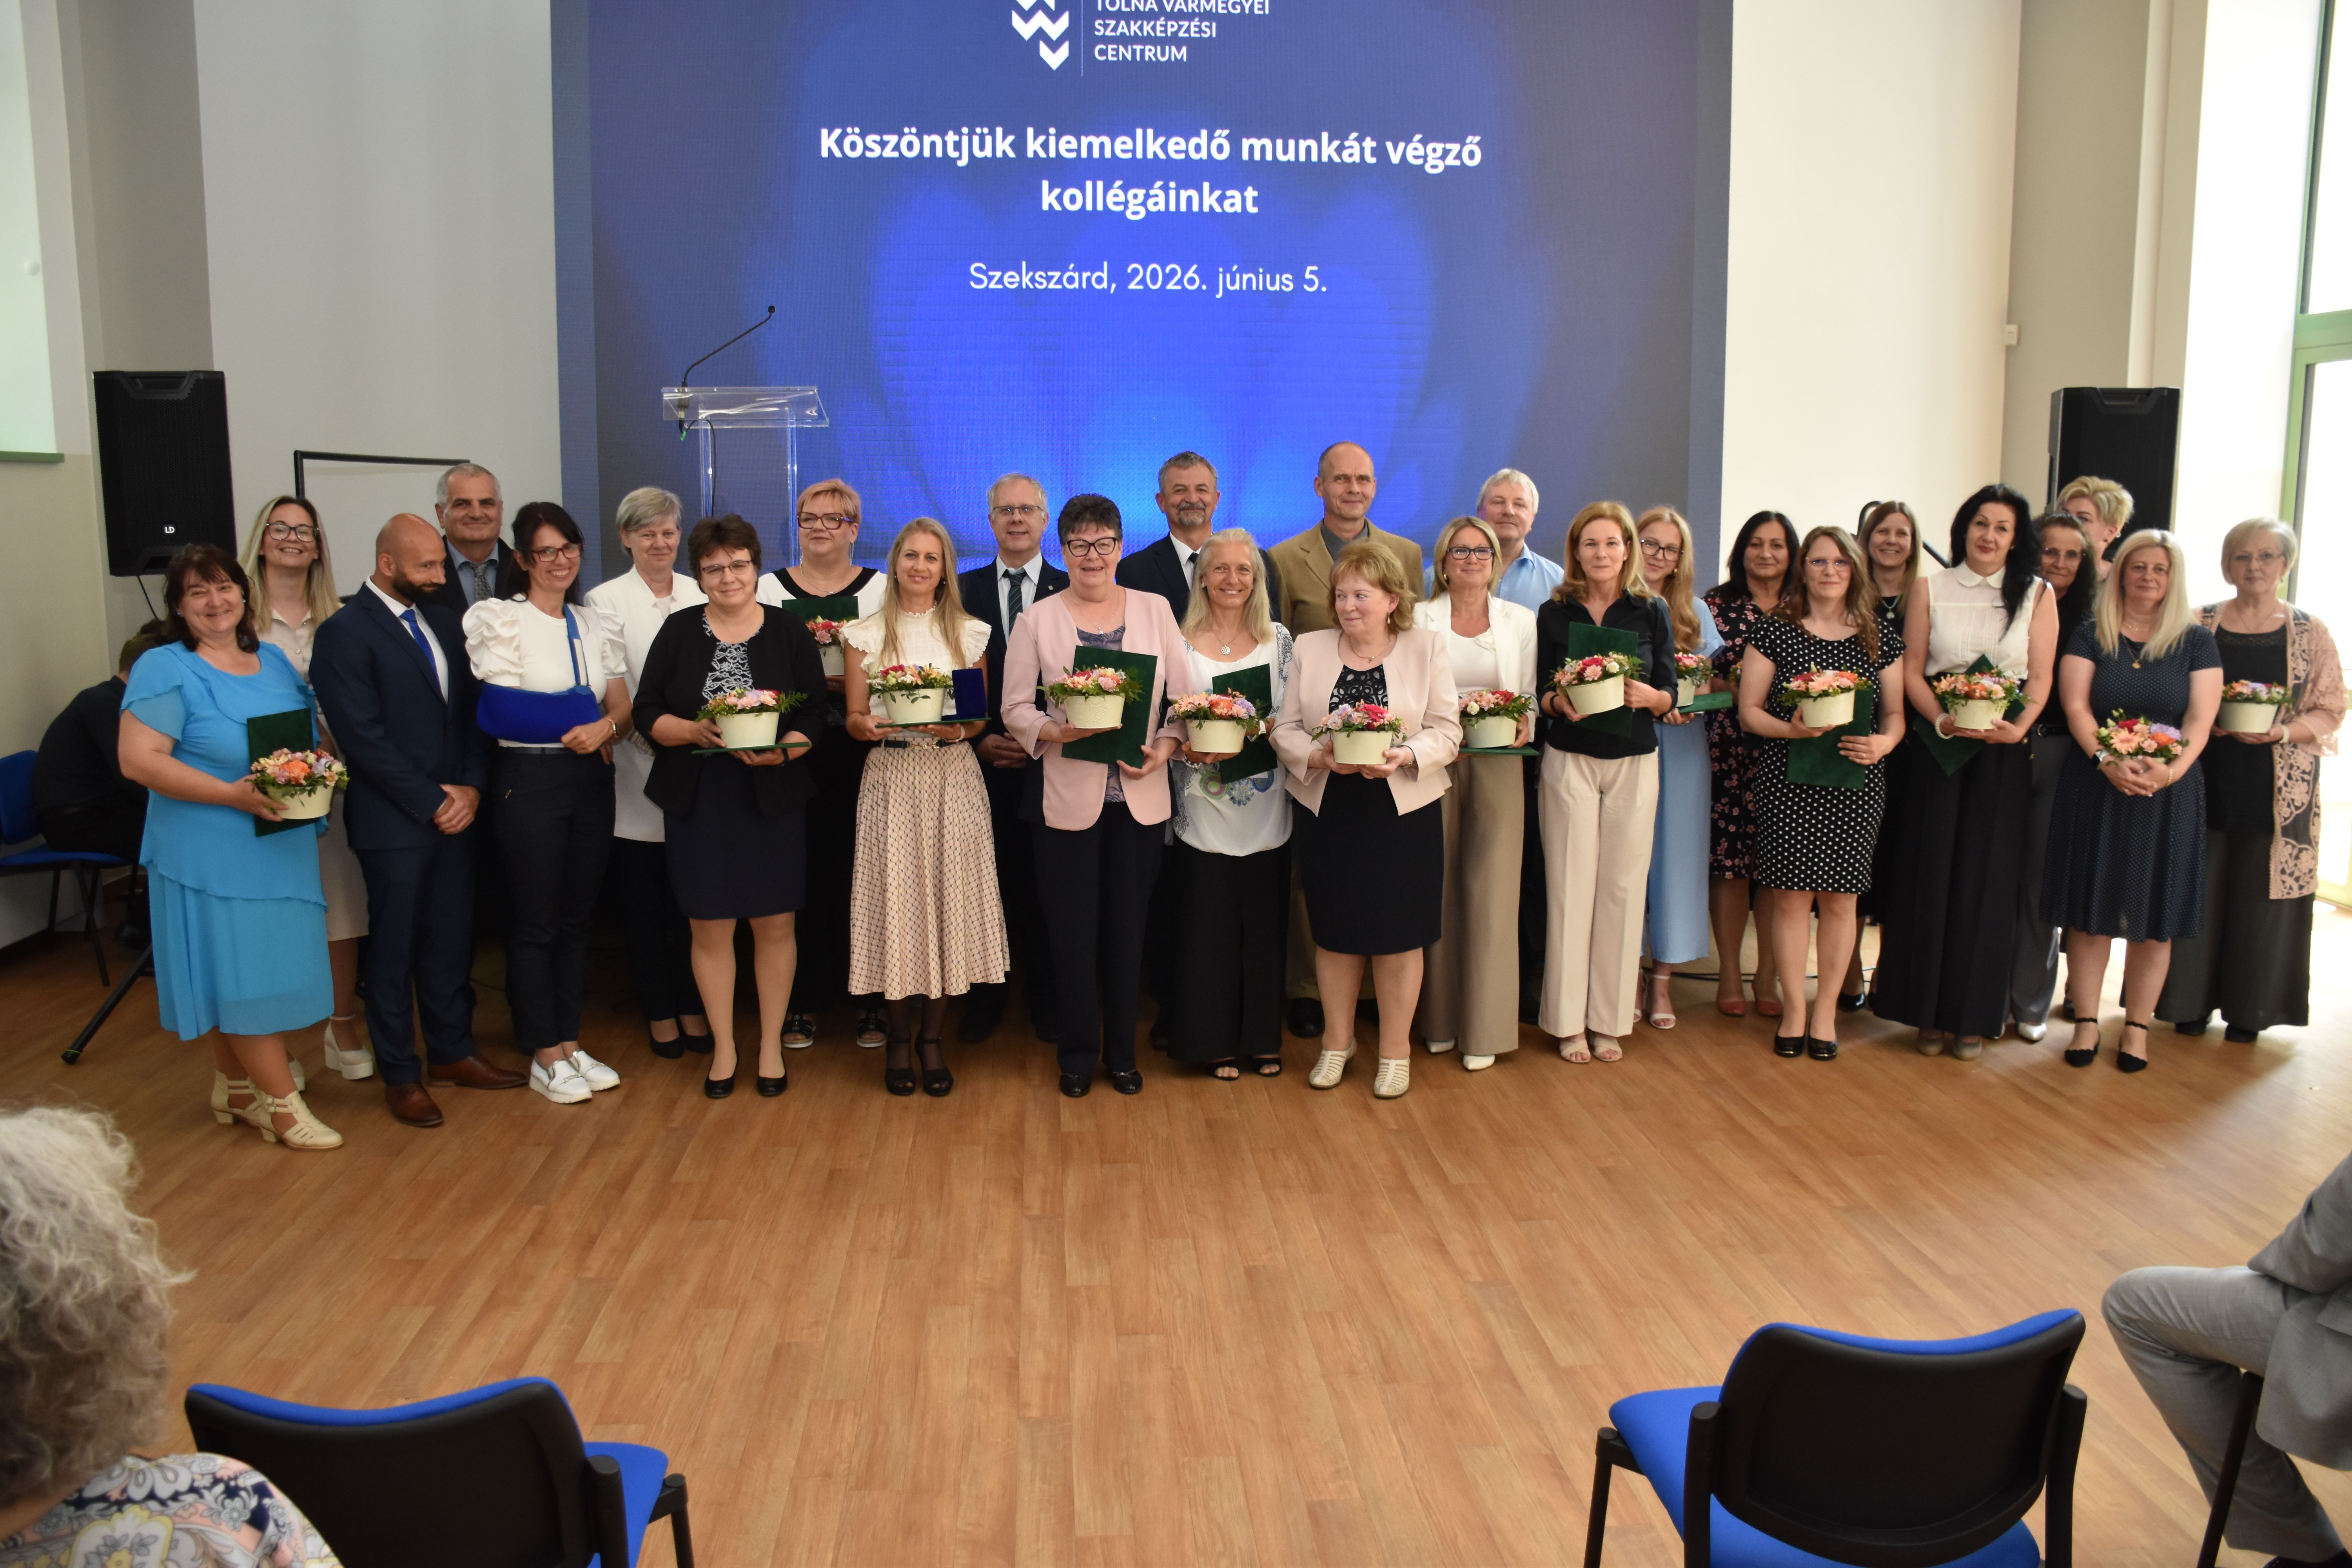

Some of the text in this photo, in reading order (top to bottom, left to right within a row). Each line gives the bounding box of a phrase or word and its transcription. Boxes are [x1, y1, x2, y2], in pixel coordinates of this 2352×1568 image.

[1094, 17, 1216, 38] SZAKKÉPZÉSI
[1094, 44, 1187, 62] CENTRUM
[820, 127, 1482, 174] Köszöntjük kiemelkedő munkát végző
[1042, 180, 1258, 220] kollégáinkat
[970, 260, 1327, 299] Szekszárd, 2026. június 5.
